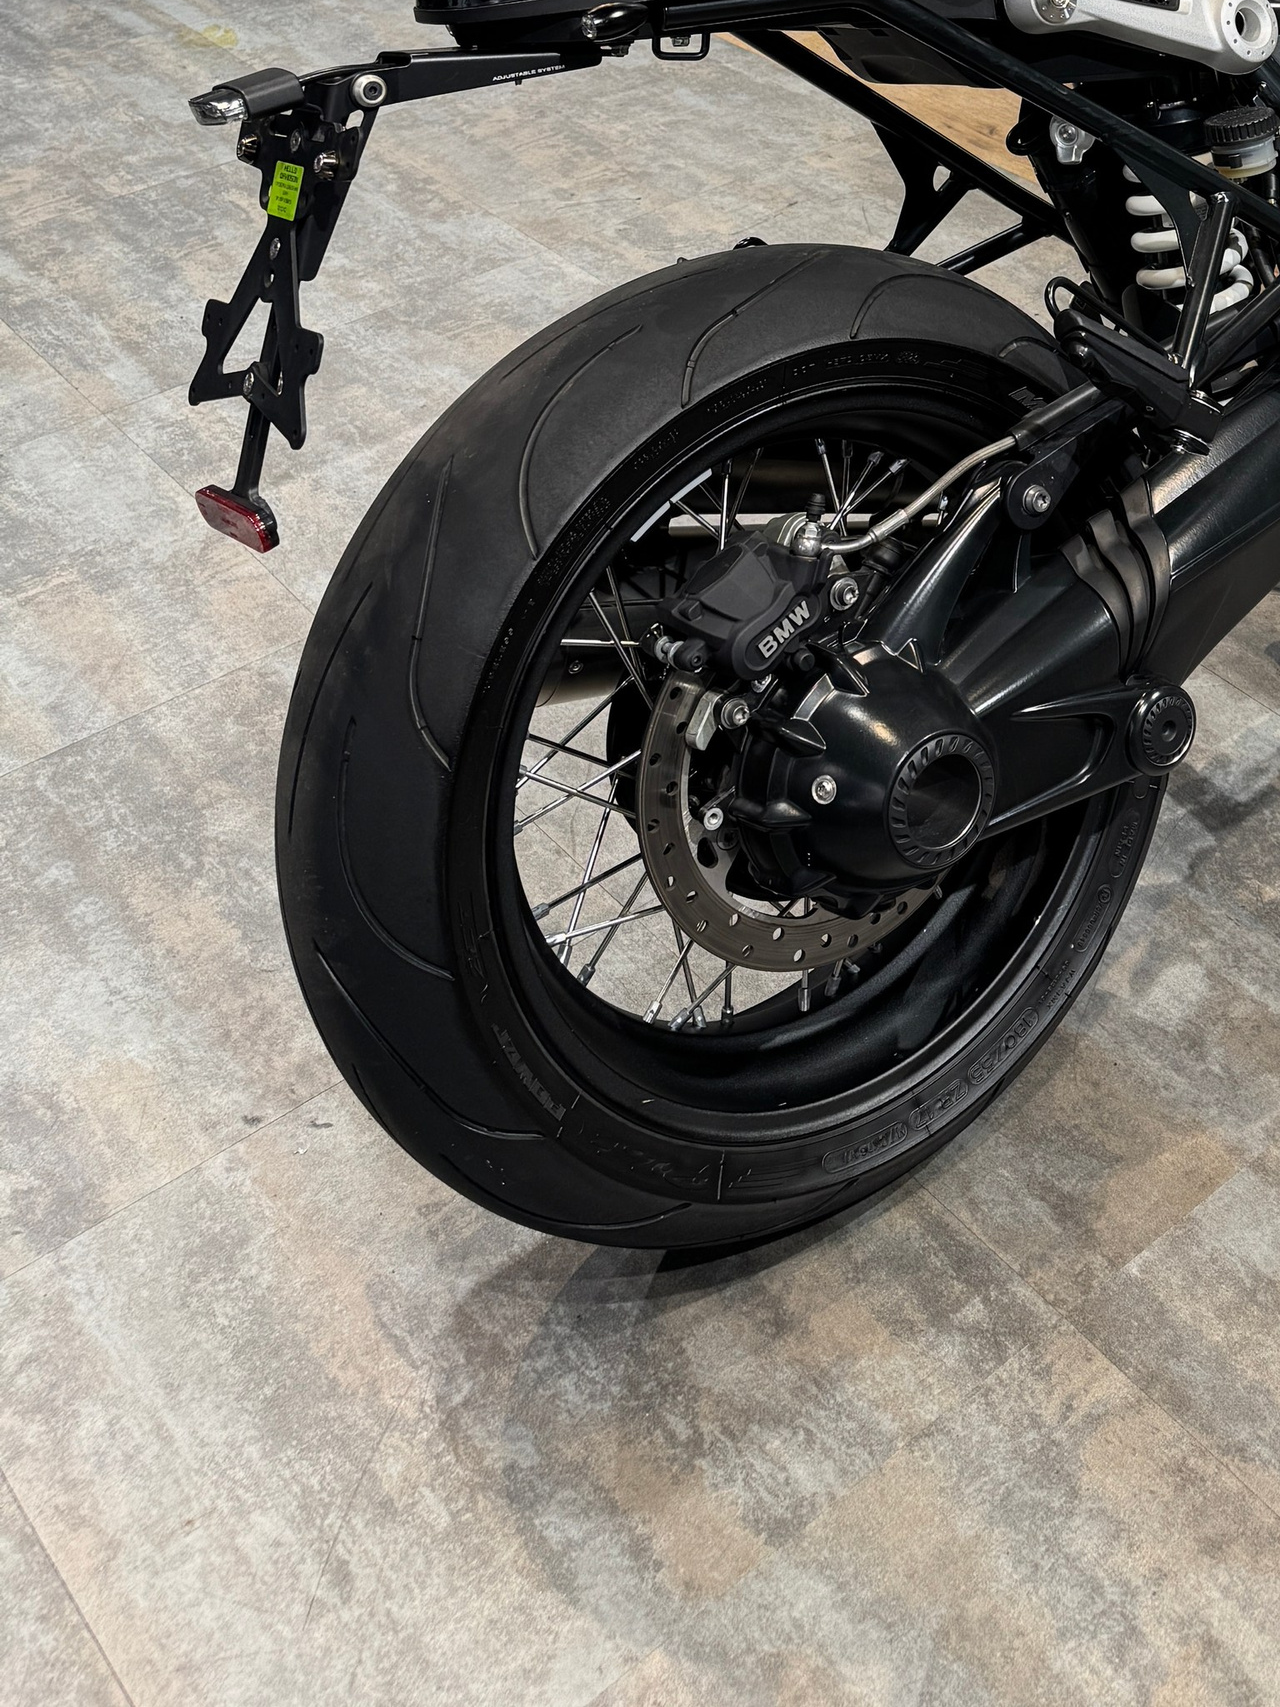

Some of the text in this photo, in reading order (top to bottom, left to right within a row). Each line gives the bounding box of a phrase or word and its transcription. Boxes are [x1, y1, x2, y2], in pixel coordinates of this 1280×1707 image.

[492, 64, 566, 82] ADJUSTABLE SYSTEM
[757, 599, 811, 659] BMW
